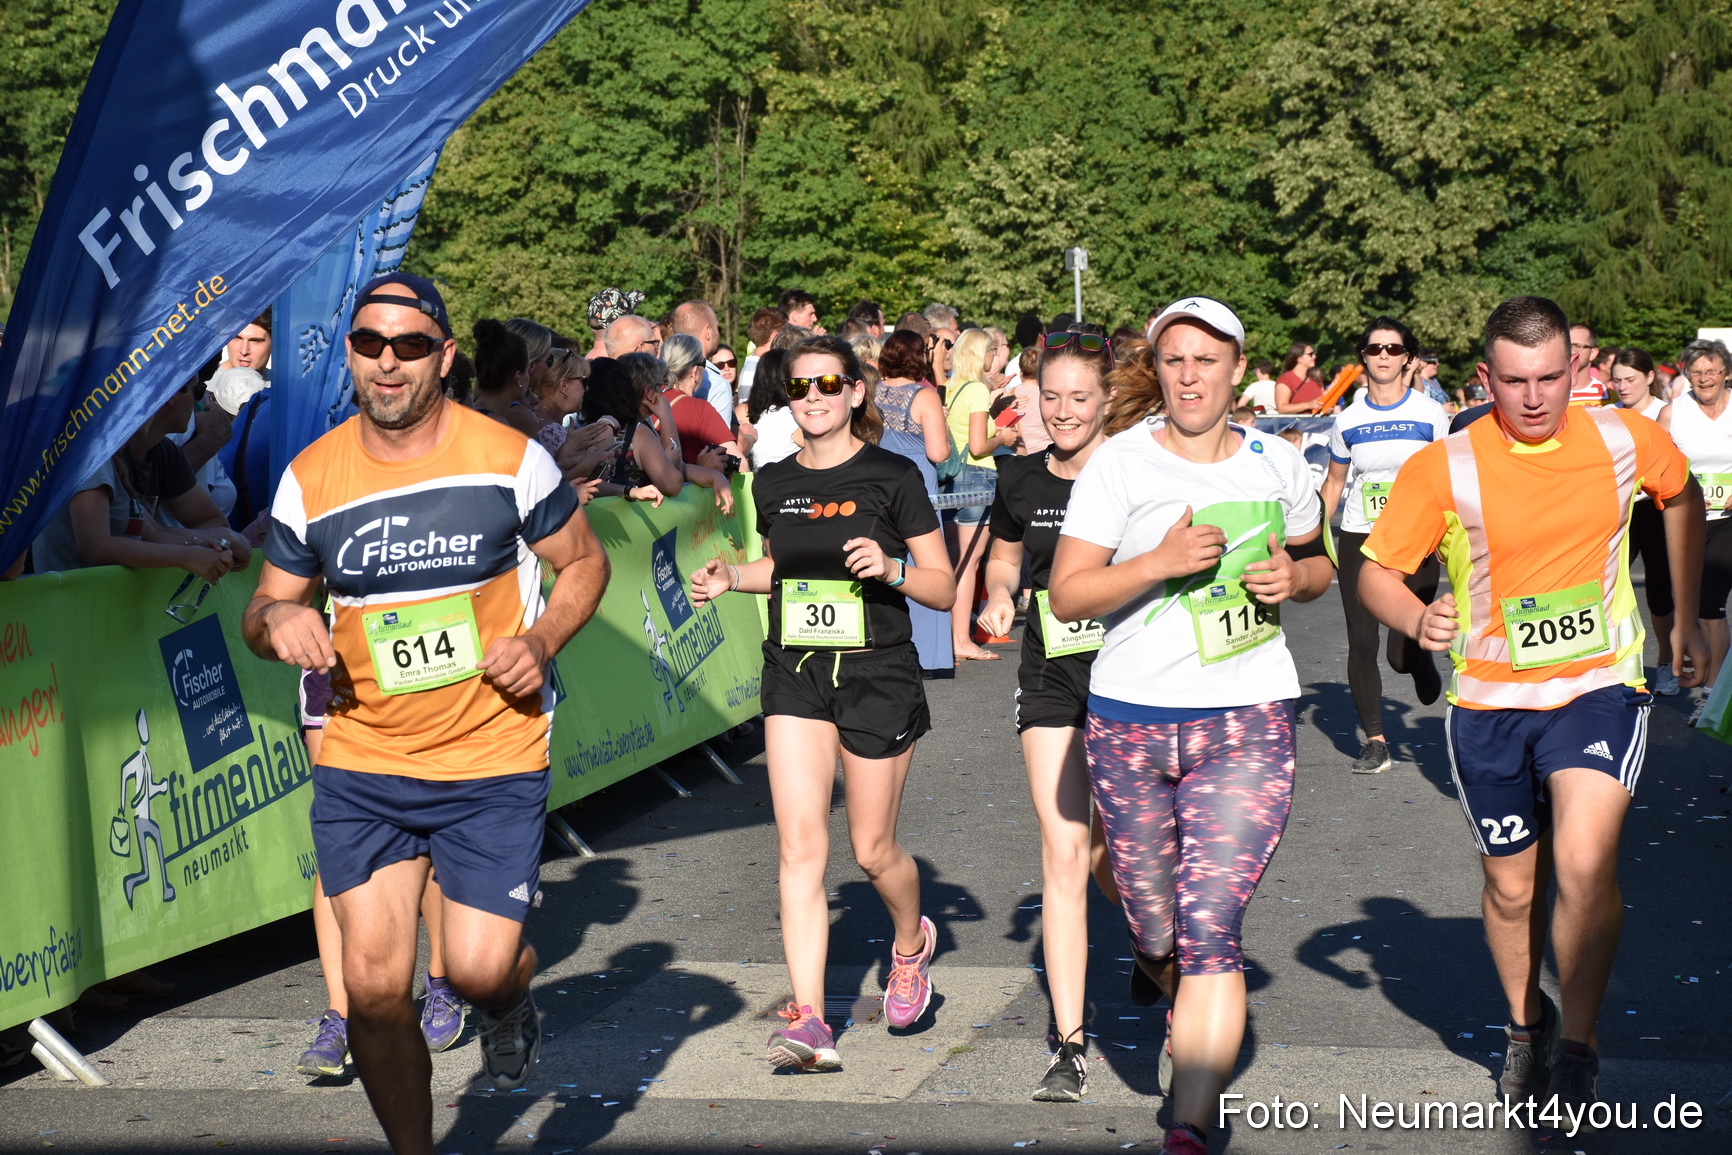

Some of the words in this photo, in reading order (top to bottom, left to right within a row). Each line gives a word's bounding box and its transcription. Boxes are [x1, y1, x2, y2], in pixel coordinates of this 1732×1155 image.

[337, 25, 436, 118] Druck
[78, 0, 407, 289] Frischma
[1374, 424, 1415, 433] PLAST
[362, 531, 483, 567] Fischer
[376, 555, 476, 577] AUTOMOBILE
[805, 603, 836, 627] 30
[1219, 601, 1267, 637] 116
[1518, 608, 1595, 648] 2085
[392, 630, 455, 669] 614
[1062, 632, 1096, 643] Klingshirn
[1225, 633, 1249, 645] Sander
[1250, 627, 1265, 637] Julia
[182, 663, 223, 698] Fischer
[400, 670, 421, 679] Emra
[422, 661, 457, 674] Thomas
[415, 672, 447, 682] Automobile
[448, 665, 466, 675] GmbH
[192, 685, 226, 710] AUTOMOBILE
[1583, 748, 1614, 761] adidas
[1481, 815, 1531, 844] 22
[183, 825, 249, 887] neumarkt
